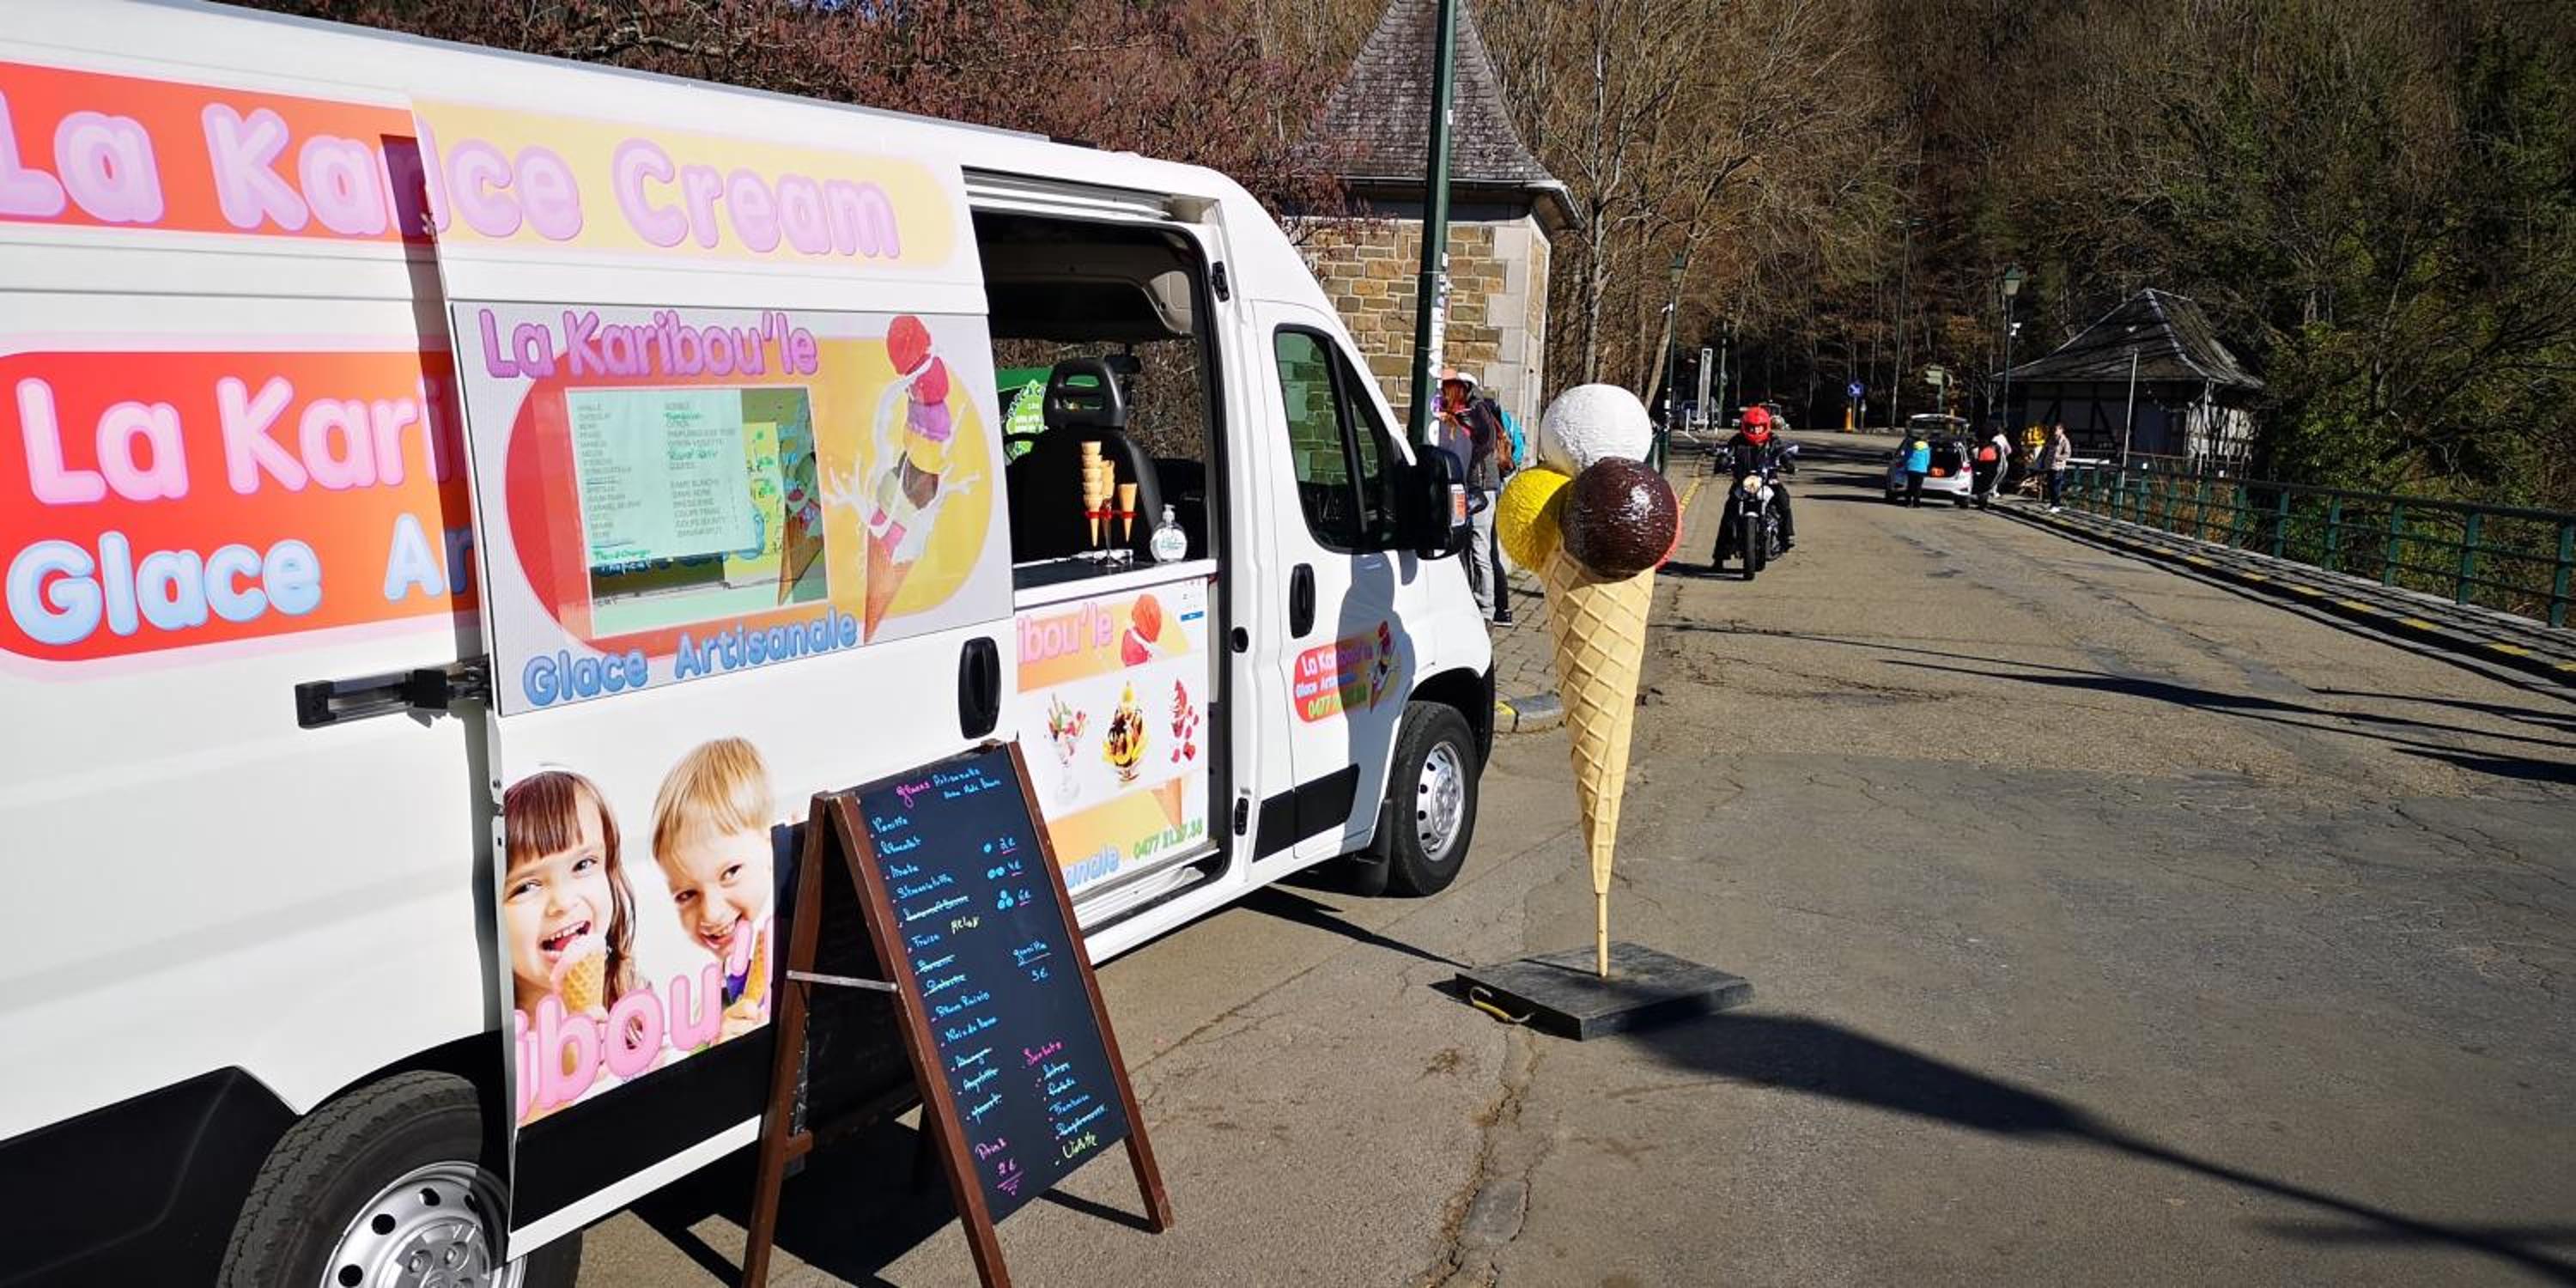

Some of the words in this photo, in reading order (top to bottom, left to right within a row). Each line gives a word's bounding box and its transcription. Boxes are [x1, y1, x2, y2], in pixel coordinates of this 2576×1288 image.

[0, 88, 164, 223] La
[611, 136, 905, 259] Cream
[479, 308, 554, 379] La
[562, 308, 818, 376] Karibou'le
[15, 377, 189, 507] La
[216, 374, 468, 495] Kari
[6, 531, 322, 644] Glace
[523, 650, 647, 707] Glace
[674, 605, 857, 679] Artisanale
